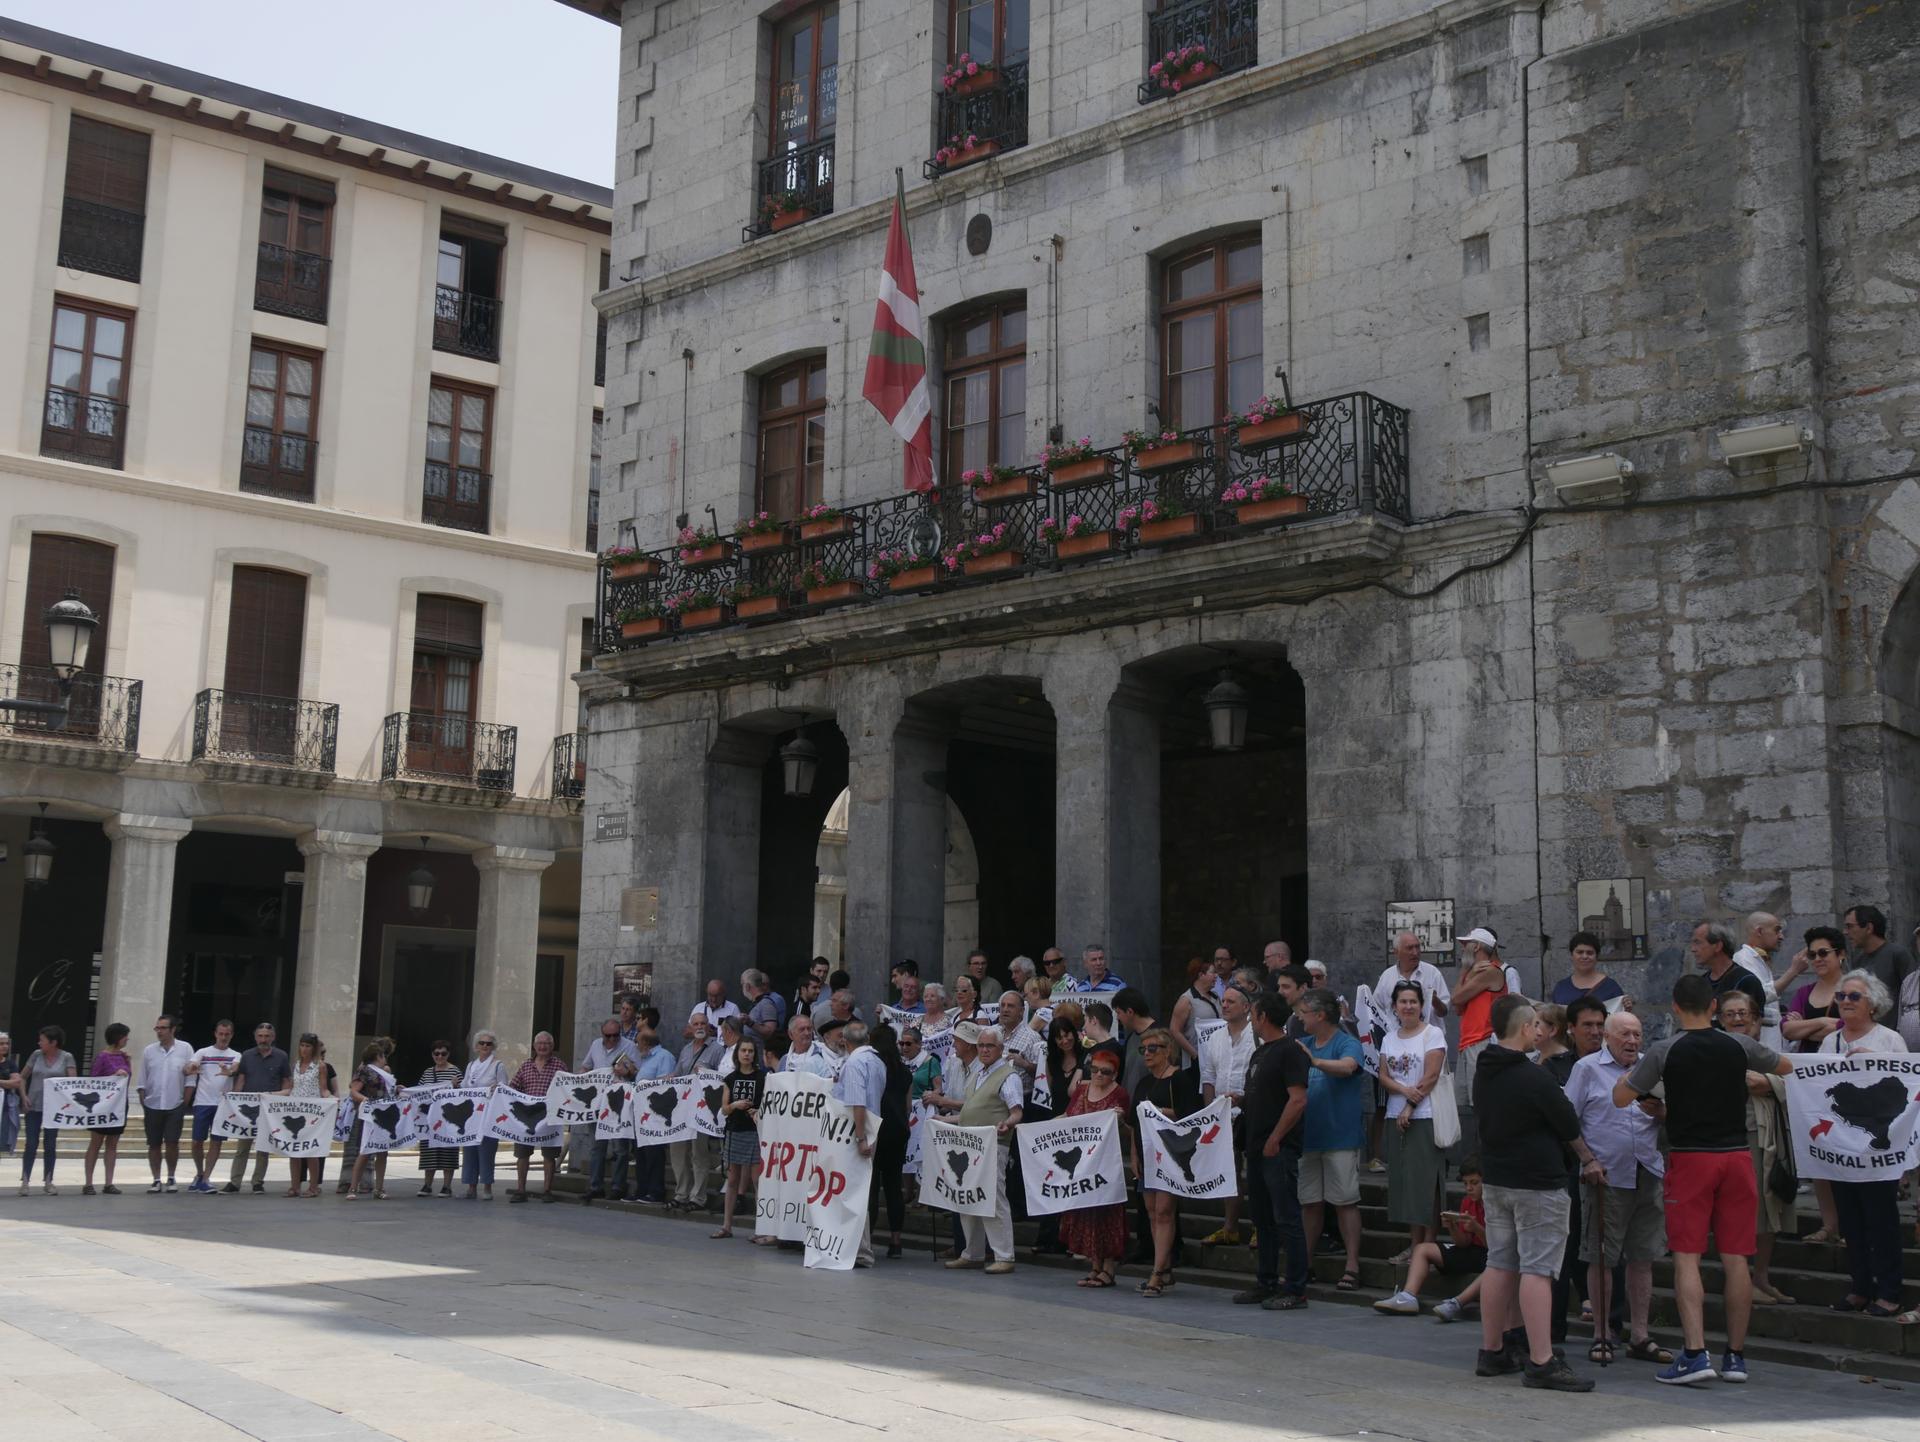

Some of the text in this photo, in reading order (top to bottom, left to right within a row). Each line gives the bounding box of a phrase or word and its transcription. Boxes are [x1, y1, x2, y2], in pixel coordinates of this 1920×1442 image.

[1795, 1060, 1860, 1080] EUSKAL
[300, 1102, 322, 1110] PRESO
[53, 1112, 119, 1126] ETXERA
[268, 1133, 320, 1152] ETXERA
[491, 1126, 560, 1143] EUSKAL HERRIRA
[936, 1130, 983, 1144] EUSKAL PRESO
[1031, 1134, 1103, 1154] ETA IHESLARIAK
[1034, 1127, 1101, 1146] EUSKAL PRESO
[1809, 1145, 1866, 1168] EUSKAL
[935, 1176, 987, 1204] ETXERA
[1041, 1173, 1108, 1199] ETXERA
